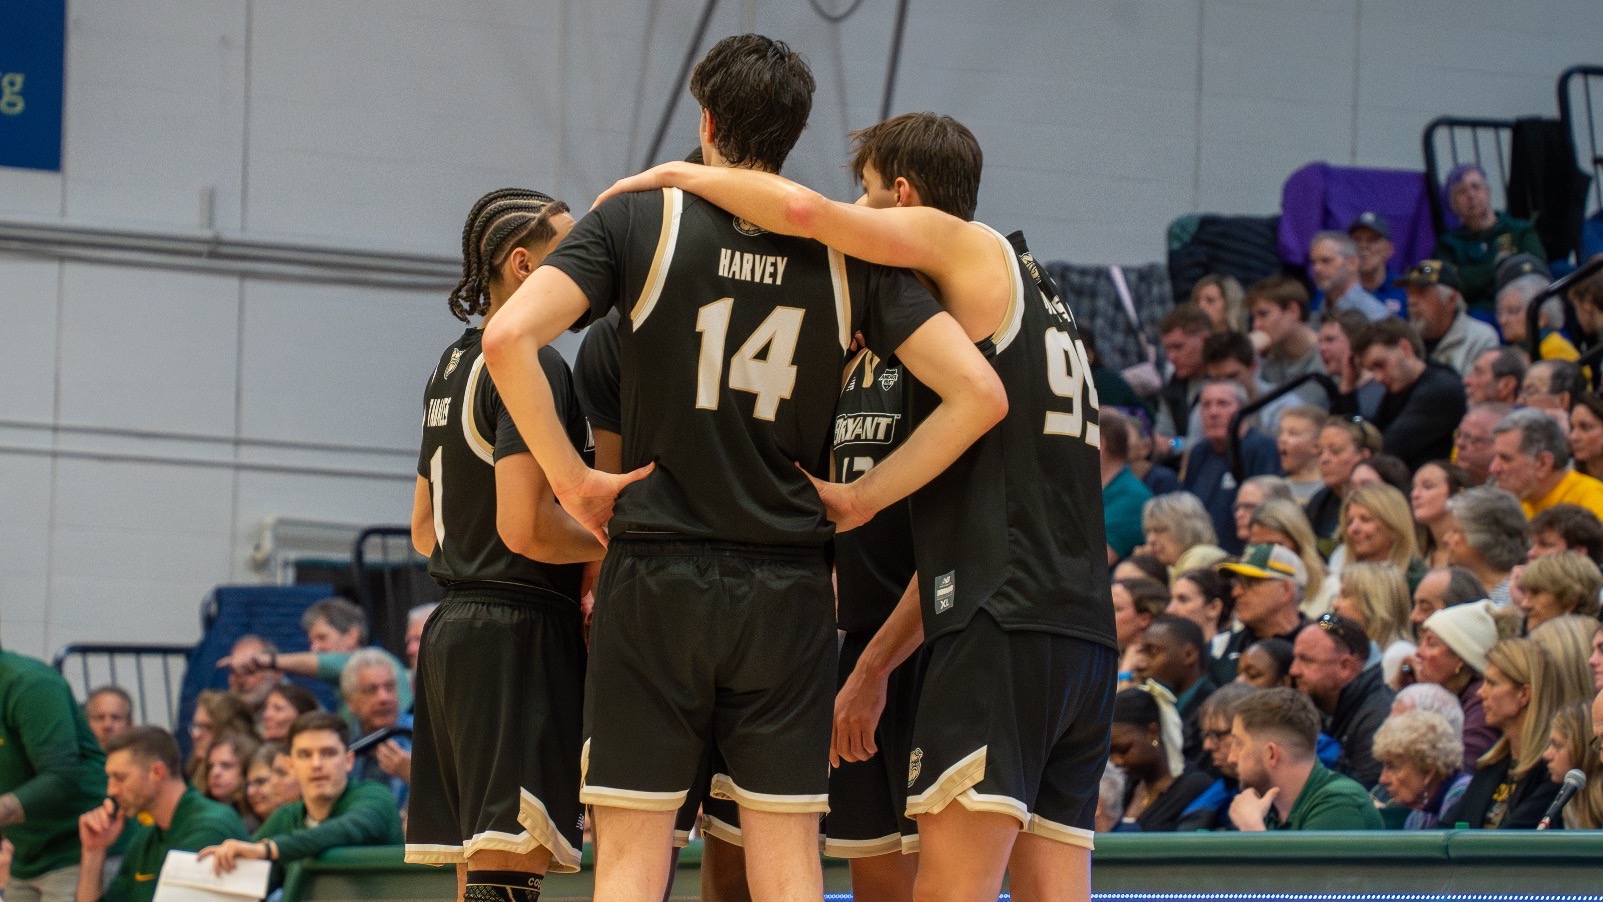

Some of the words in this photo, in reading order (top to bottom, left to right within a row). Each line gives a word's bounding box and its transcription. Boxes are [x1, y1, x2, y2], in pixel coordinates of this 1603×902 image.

[718, 247, 788, 285] HARVEY
[695, 297, 806, 422] 14
[940, 599, 949, 609] XL
